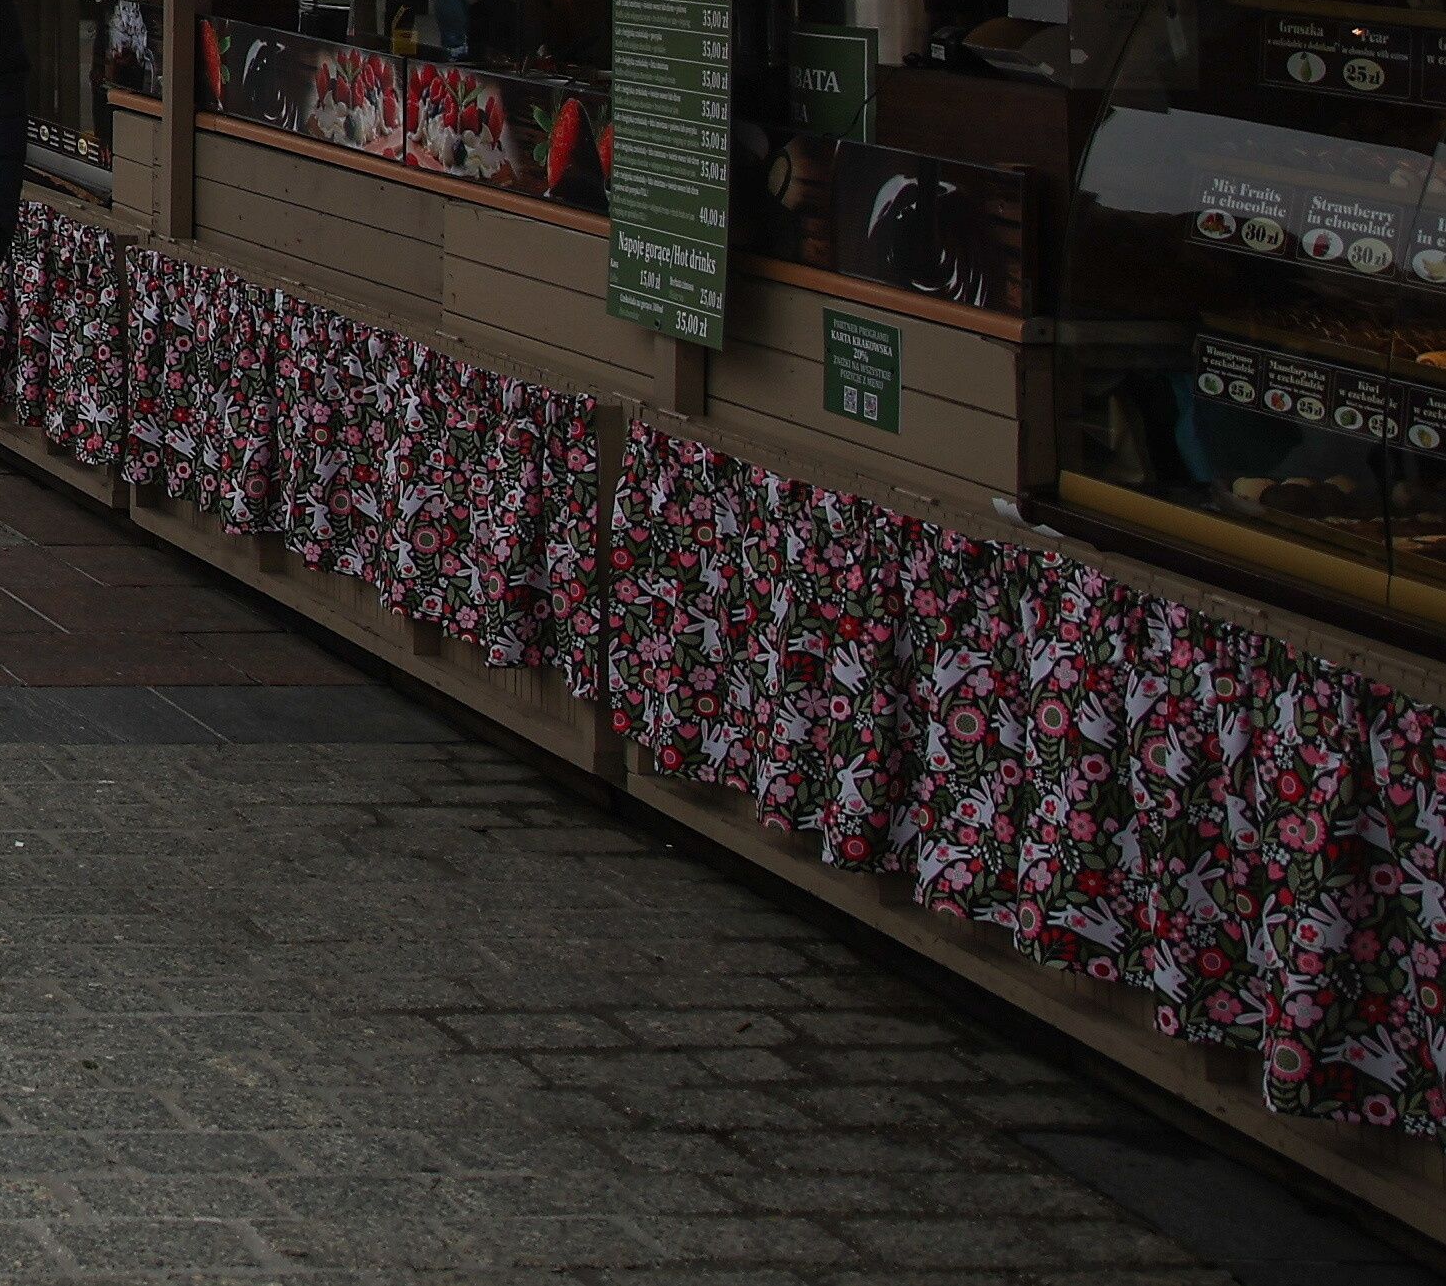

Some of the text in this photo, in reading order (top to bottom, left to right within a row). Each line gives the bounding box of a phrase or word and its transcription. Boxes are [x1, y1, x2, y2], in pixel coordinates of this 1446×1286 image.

[1211, 177, 1282, 203] Mix Fruits
[1202, 190, 1287, 219] in chocolate
[1312, 195, 1396, 223] Strawberry
[1307, 209, 1396, 239] in chocolate
[1416, 229, 1432, 246] in
[619, 230, 645, 260] Napoje
[689, 248, 716, 275] drinks
[675, 310, 699, 335] 35,00
